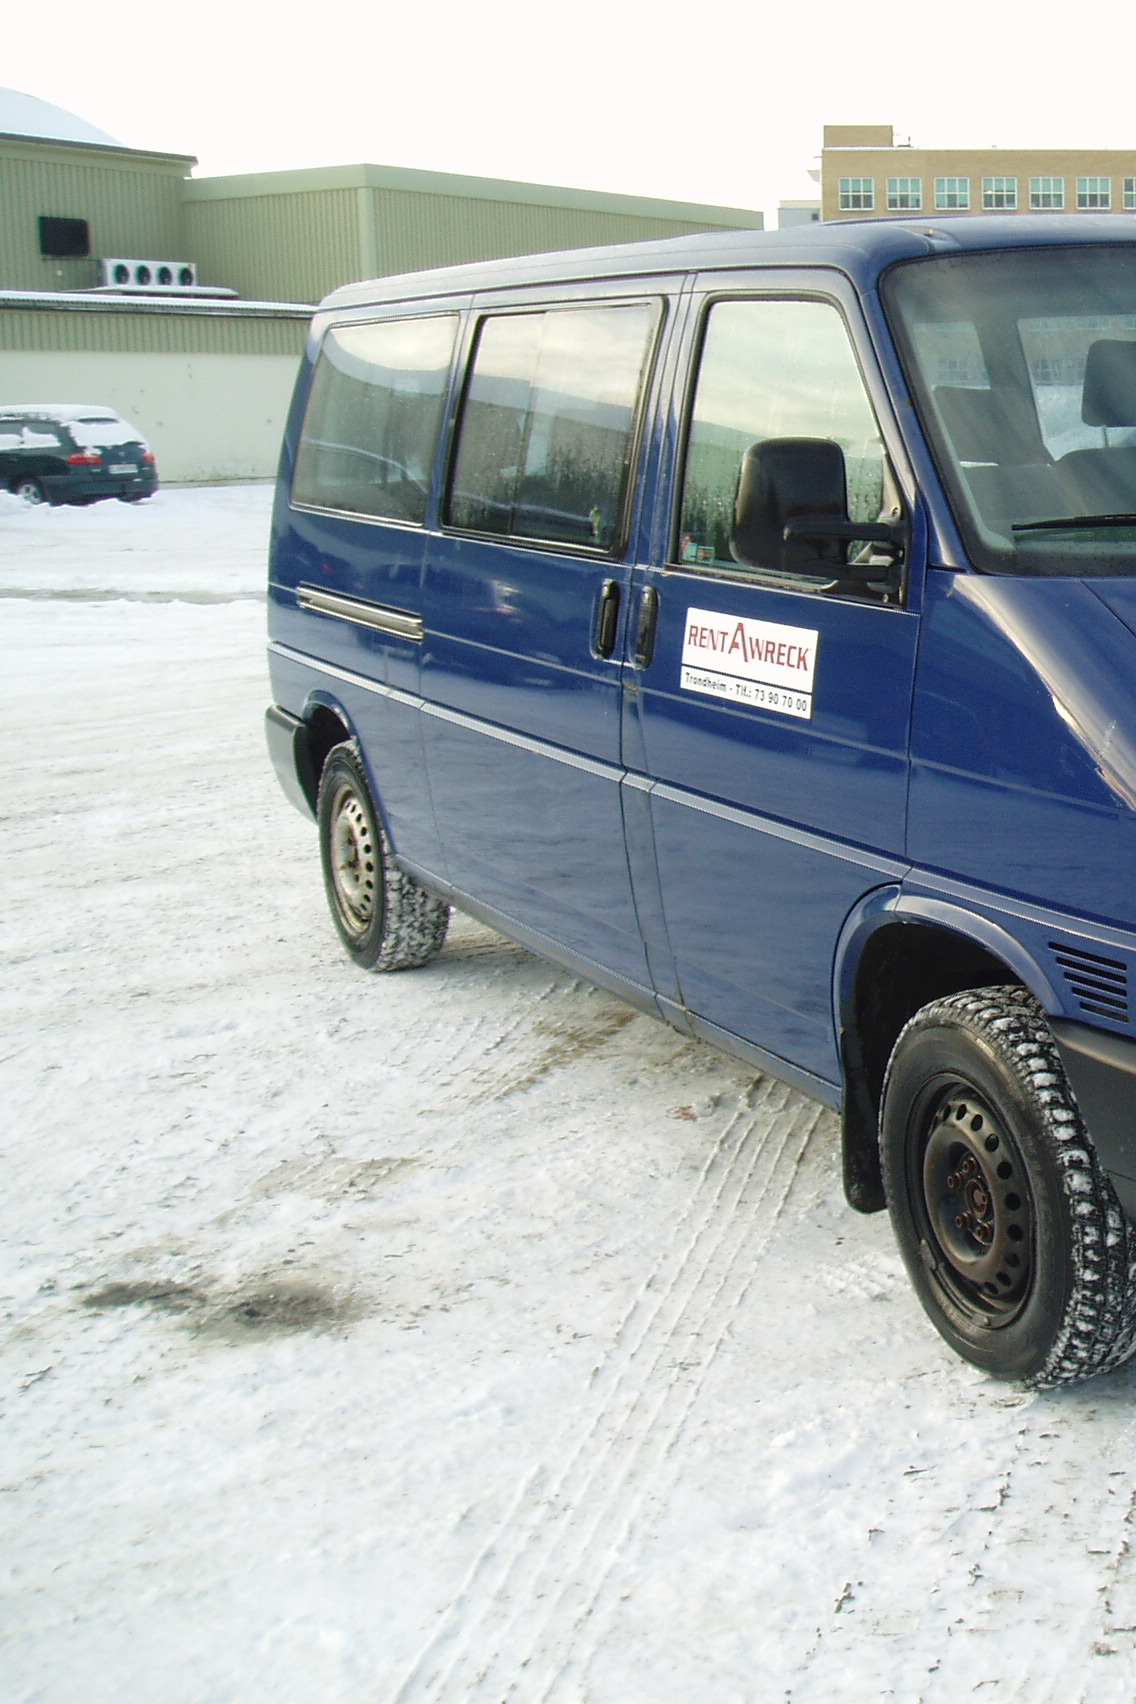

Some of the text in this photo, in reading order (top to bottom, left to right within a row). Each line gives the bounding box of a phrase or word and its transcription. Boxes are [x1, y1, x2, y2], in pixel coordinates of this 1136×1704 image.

[685, 671, 727, 693] Trondheim
[755, 688, 765, 702] 73
[768, 691, 779, 705] 90
[782, 695, 793, 708] 70
[796, 698, 807, 712] 00
